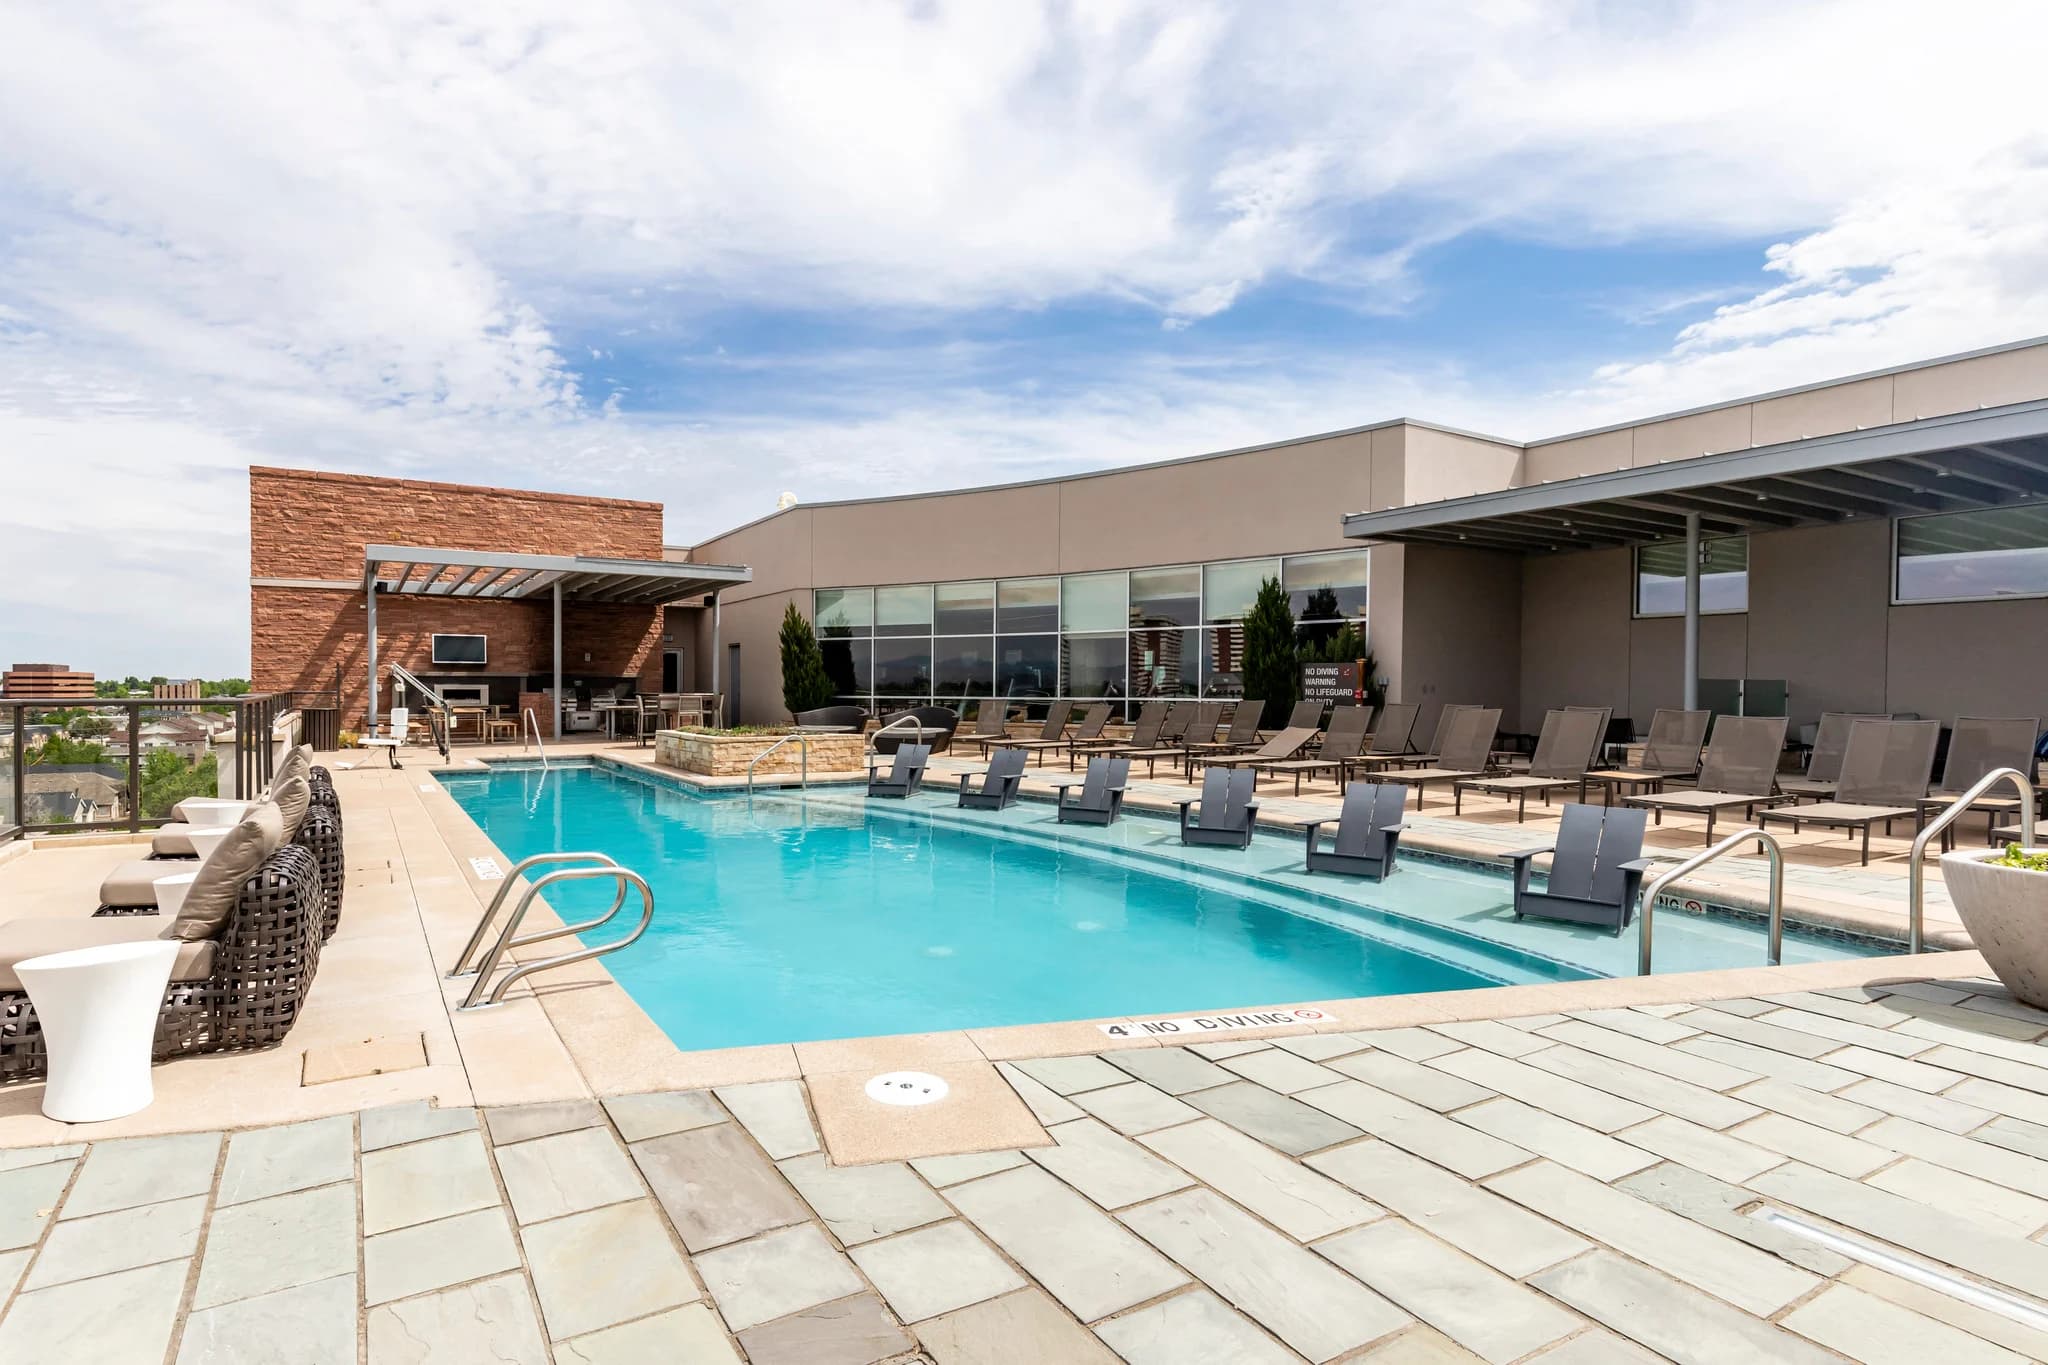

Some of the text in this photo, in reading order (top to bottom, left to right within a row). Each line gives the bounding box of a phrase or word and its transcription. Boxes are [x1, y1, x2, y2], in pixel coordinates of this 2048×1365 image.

[1305, 667, 1339, 676] NO DIVING
[1304, 678, 1336, 686] WARNING
[1304, 688, 1353, 696] NO LIFEGUARD
[1141, 1021, 1180, 1034] NO
[1193, 1012, 1294, 1030] DIVING
